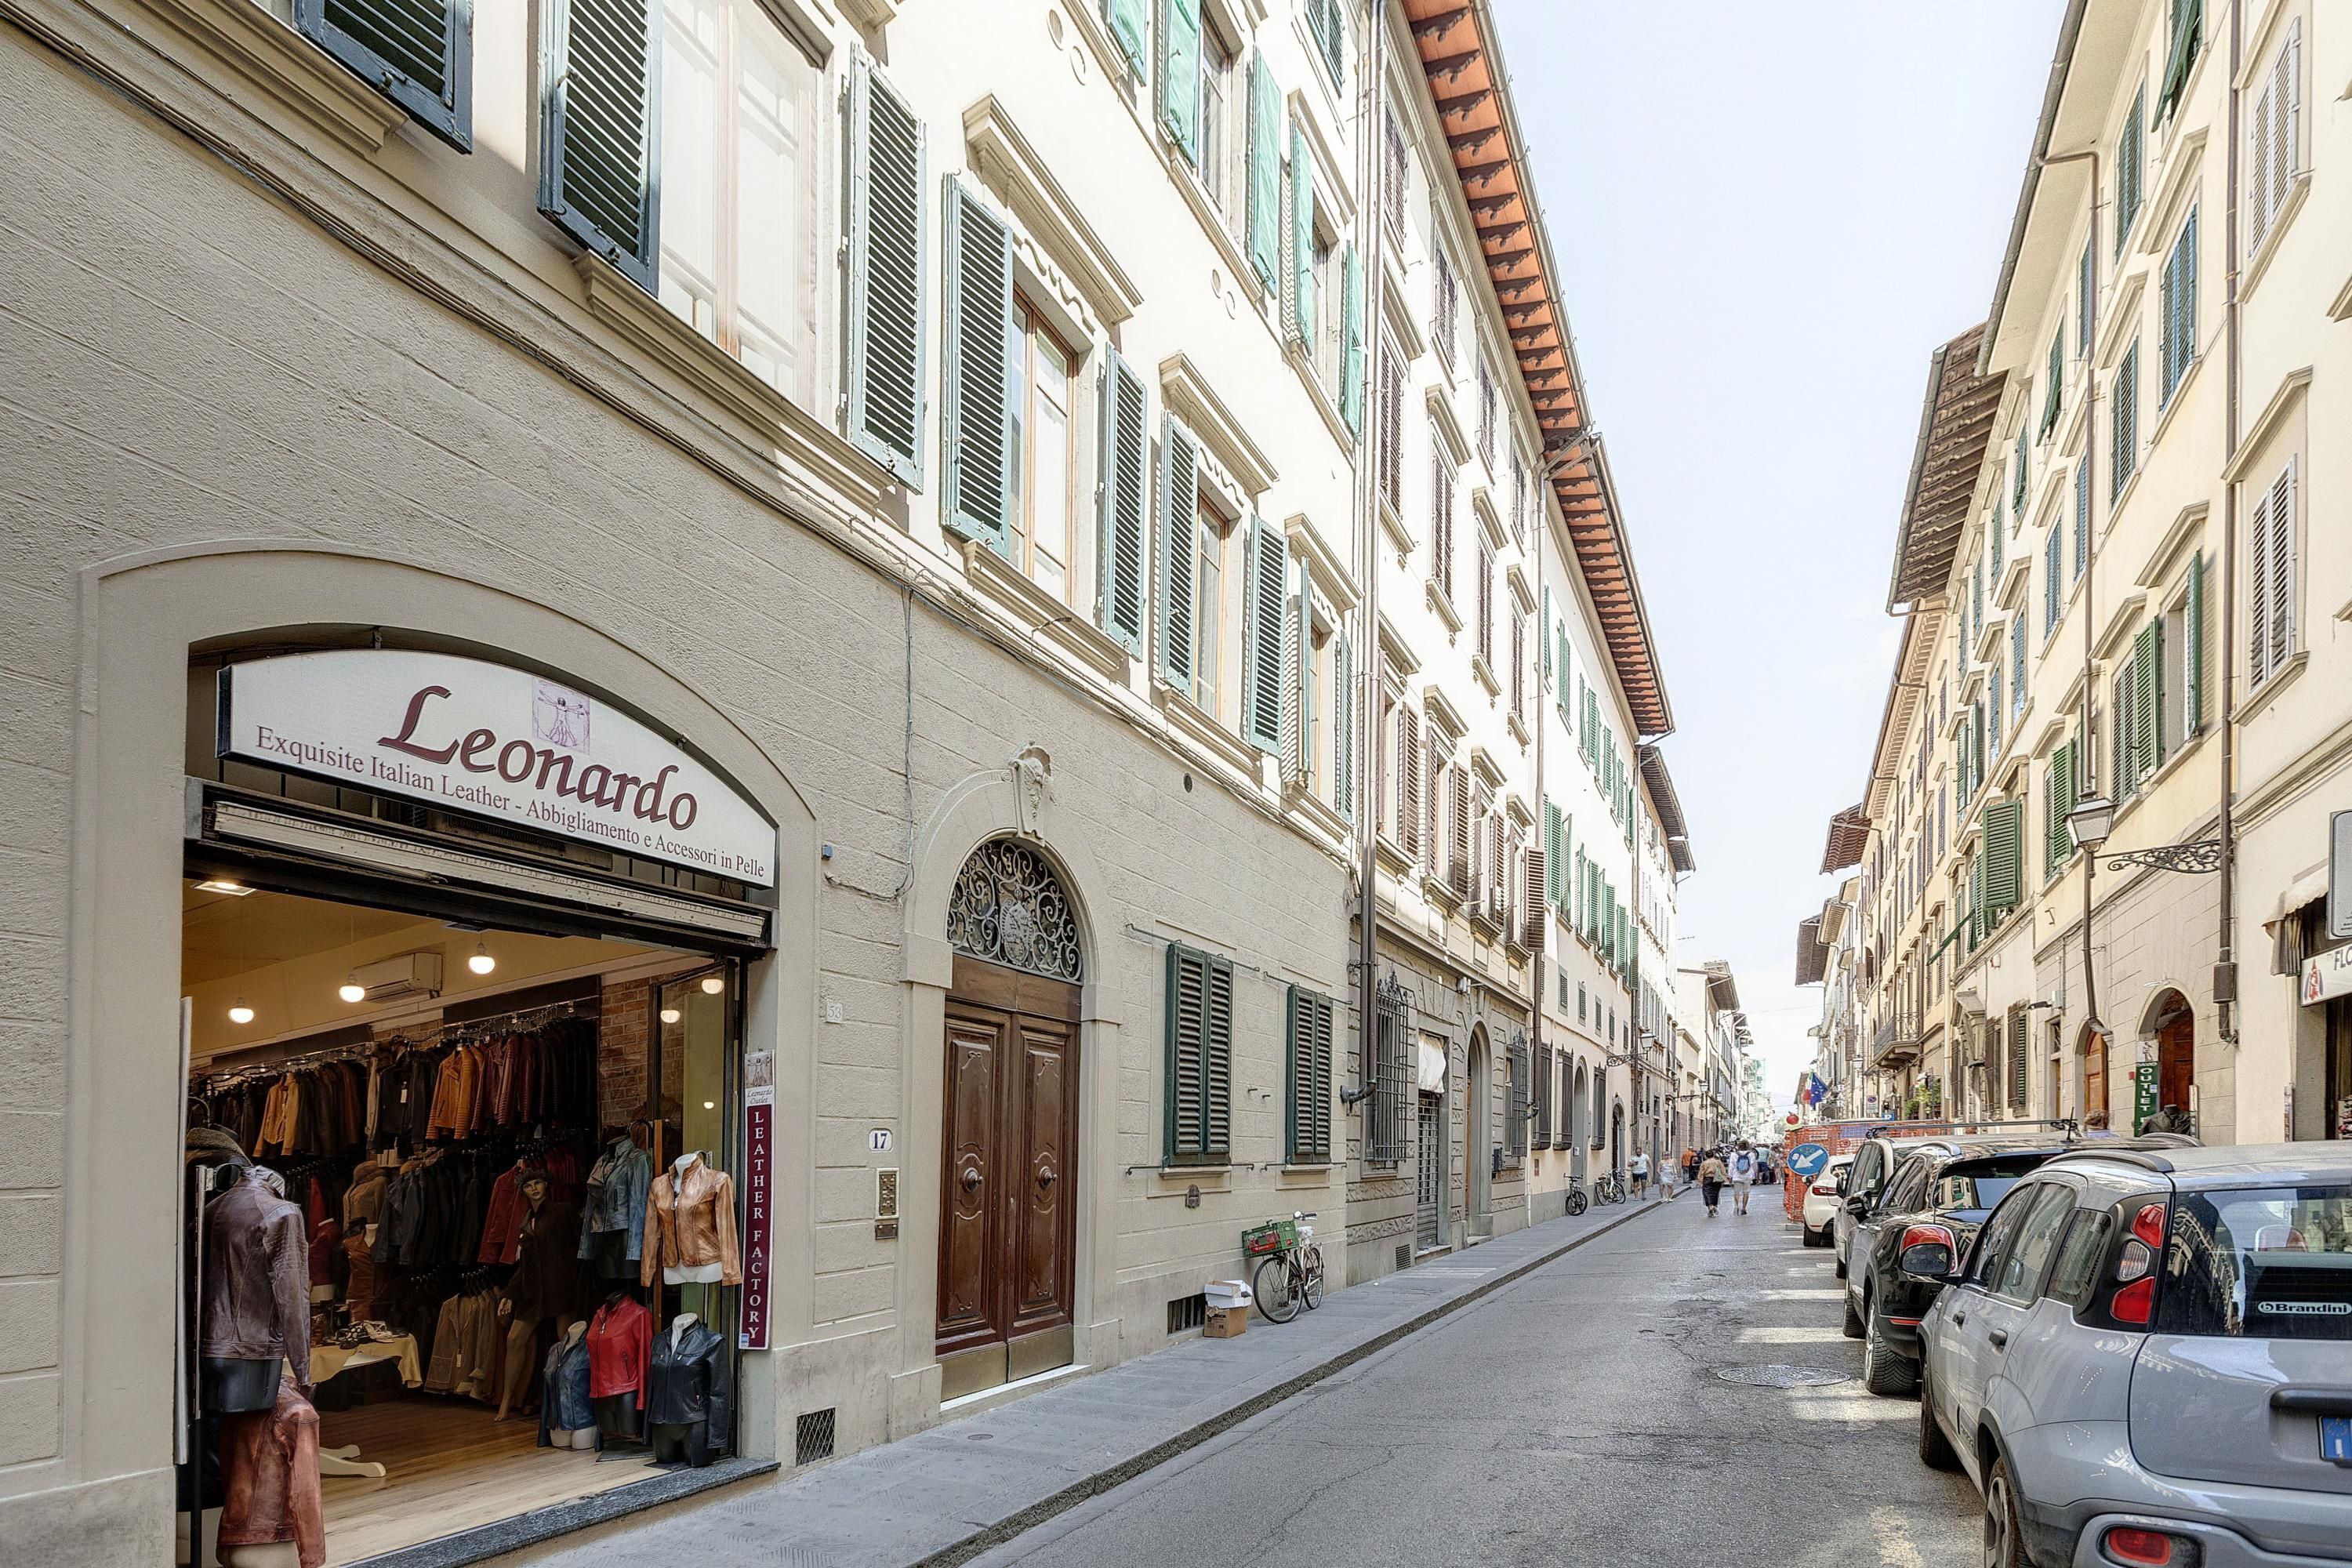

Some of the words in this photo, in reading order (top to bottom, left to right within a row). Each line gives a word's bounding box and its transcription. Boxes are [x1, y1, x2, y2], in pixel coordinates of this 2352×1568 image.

[376, 684, 698, 831] Leonardo
[256, 724, 365, 772] Exquisite
[369, 755, 435, 792] Italian
[440, 774, 510, 811] Leather
[526, 798, 640, 845] Abbigliamento
[643, 834, 652, 848] e
[655, 833, 717, 866] Accessori
[720, 850, 732, 870] in
[735, 854, 765, 878] Pelle
[827, 1005, 843, 1018] 53
[747, 1087, 772, 1098] Leonardo
[2140, 1067, 2153, 1112] OUTLET
[873, 1132, 887, 1149] 17
[753, 1111, 765, 1219] LEATHER
[748, 1230, 763, 1339] FACTORY
[2275, 1303, 2347, 1313] Brandini
[2335, 1439, 2343, 1454] I
